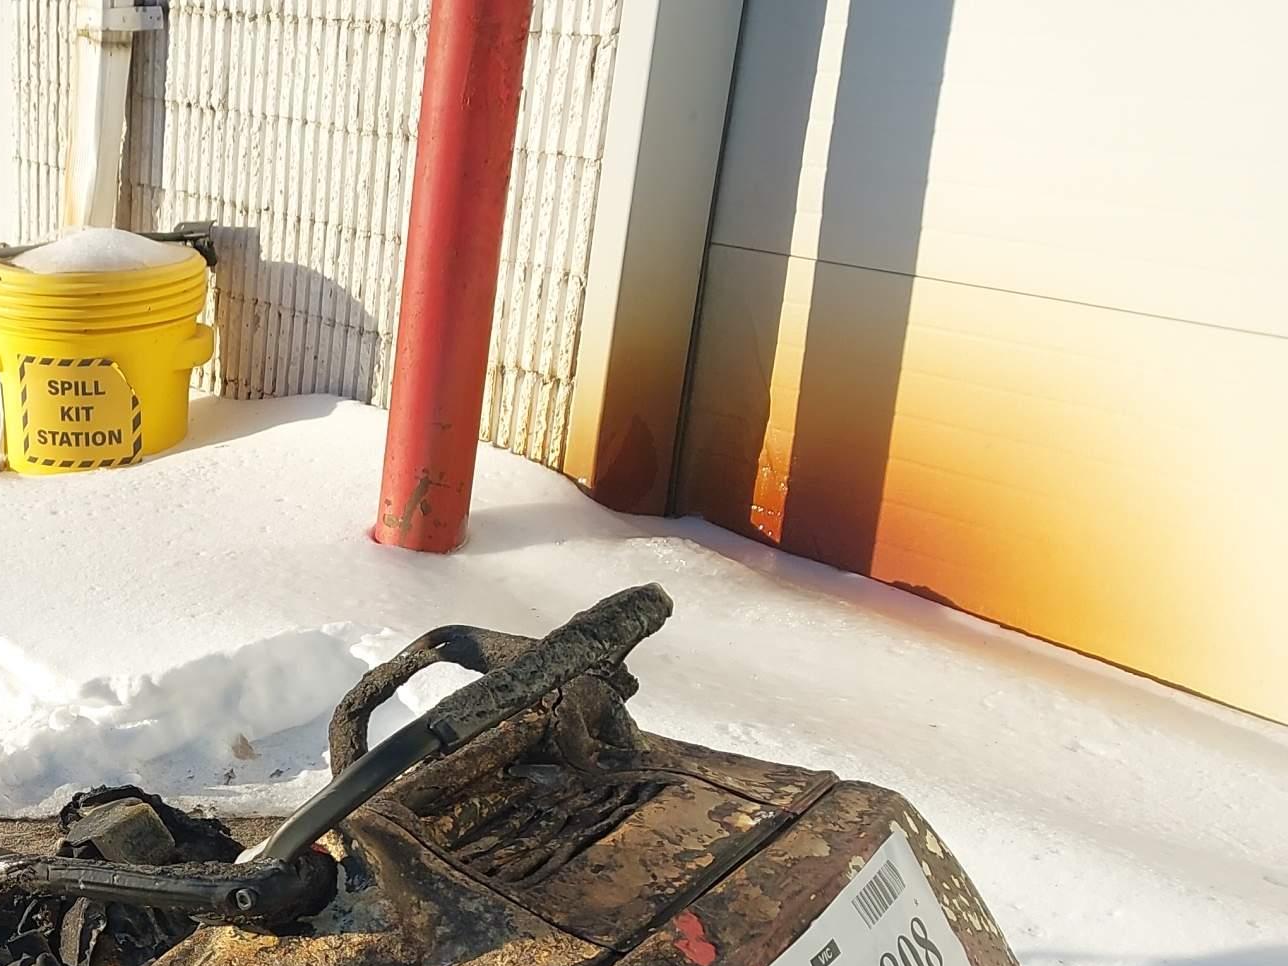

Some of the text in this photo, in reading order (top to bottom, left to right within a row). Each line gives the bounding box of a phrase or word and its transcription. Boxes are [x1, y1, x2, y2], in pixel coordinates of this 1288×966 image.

[47, 379, 106, 397] SPILL
[60, 405, 94, 422] KIT
[36, 428, 123, 447] STATION
[818, 947, 833, 966] VIC
